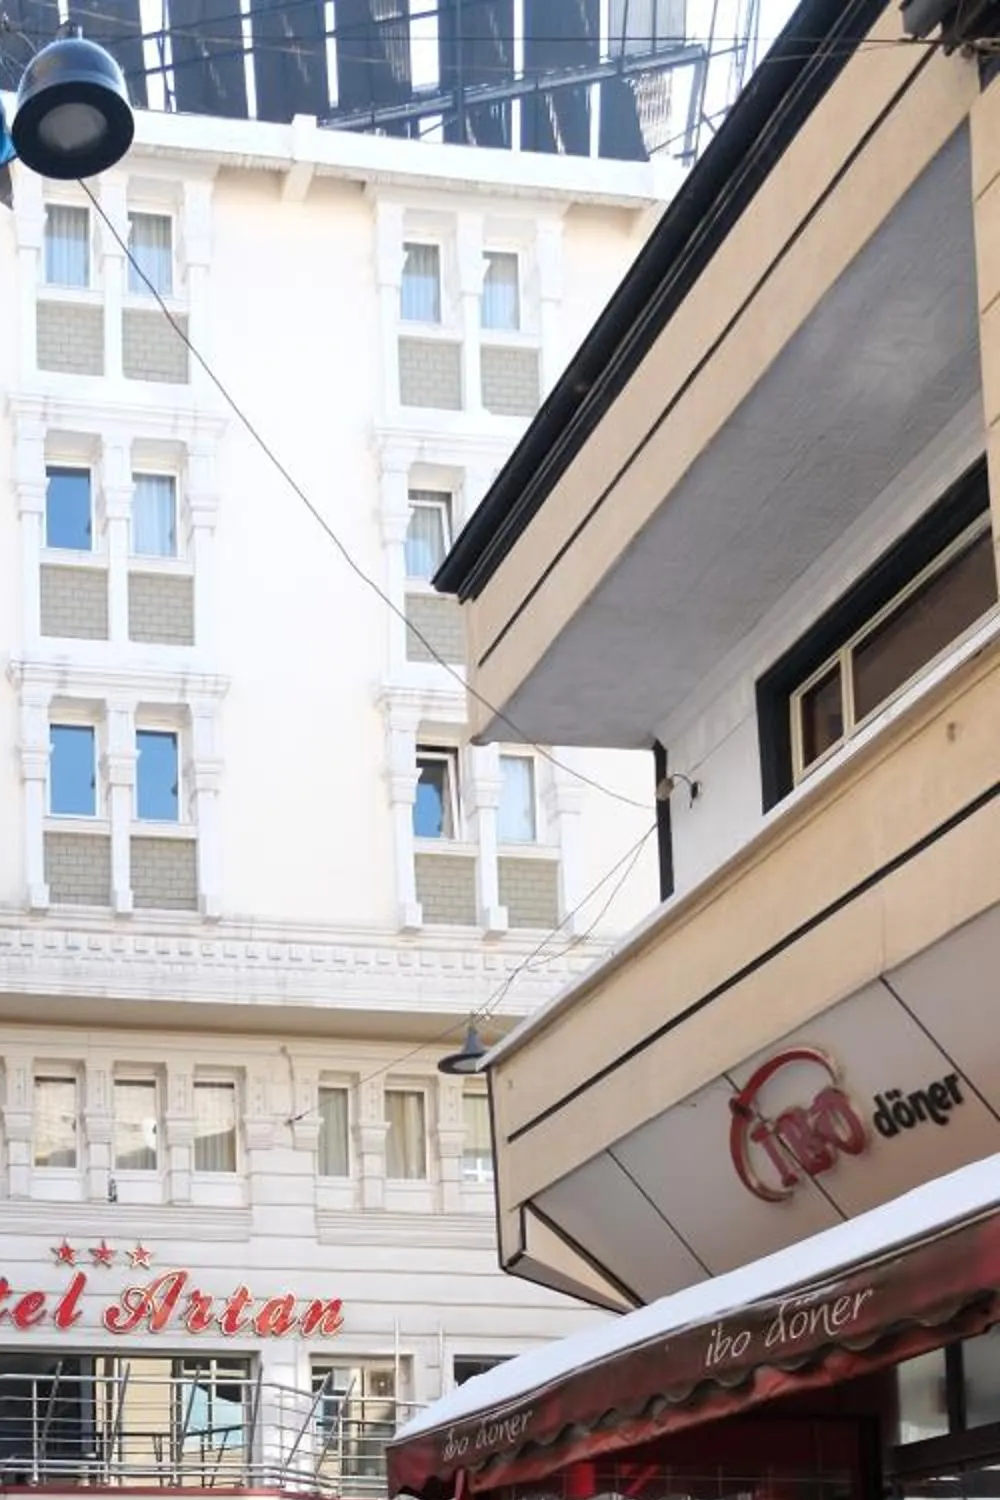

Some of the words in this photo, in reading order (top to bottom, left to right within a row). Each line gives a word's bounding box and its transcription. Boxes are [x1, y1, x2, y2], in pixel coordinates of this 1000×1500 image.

[872, 1072, 966, 1139] döner
[102, 1268, 344, 1338] Artan
[704, 1323, 751, 1367] ibo
[764, 1289, 874, 1348] döner
